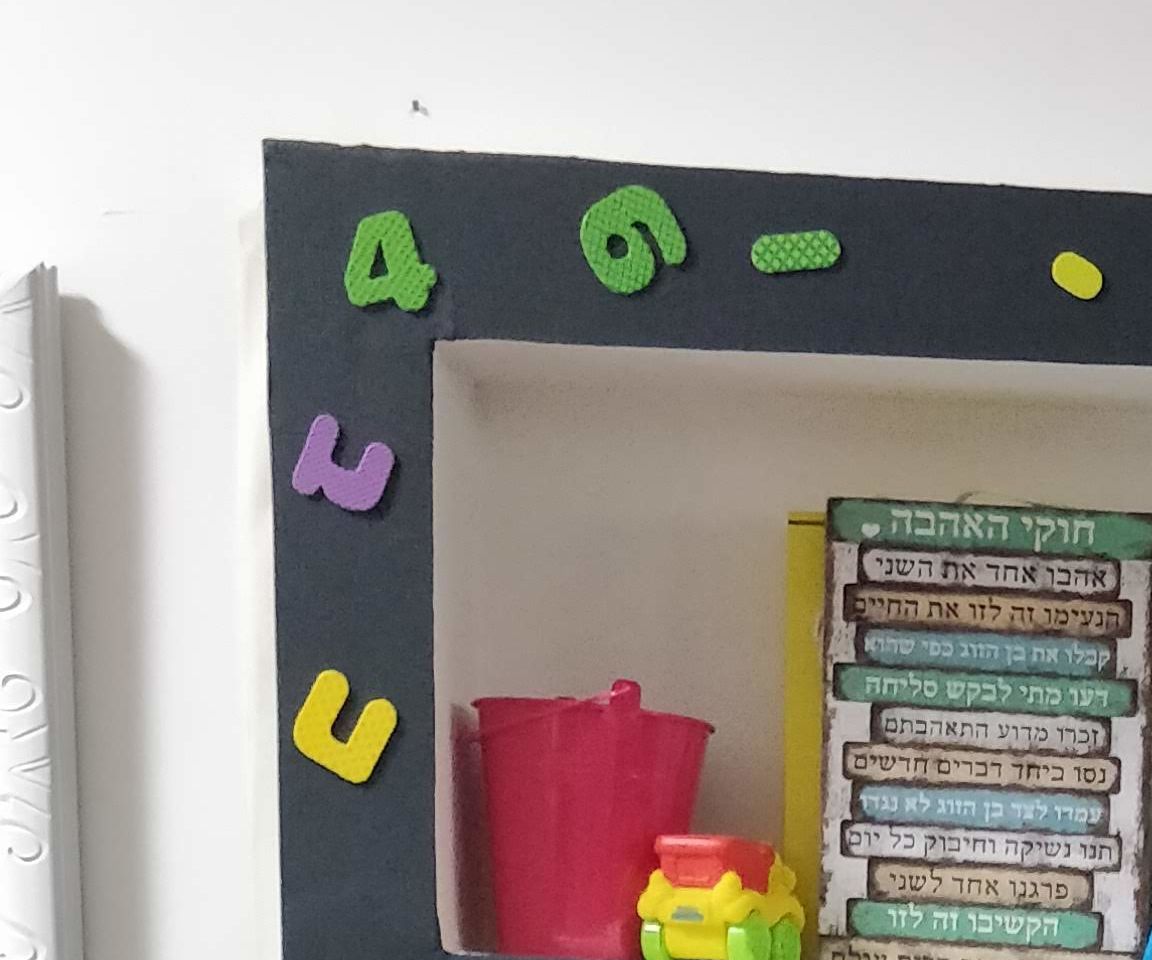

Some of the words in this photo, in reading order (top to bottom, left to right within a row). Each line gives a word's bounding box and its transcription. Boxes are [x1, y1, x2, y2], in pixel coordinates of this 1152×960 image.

[342, 210, 438, 312] 4
[890, 508, 1008, 541] האהבה
[1021, 515, 1095, 552] חוקי
[876, 556, 933, 578] השני
[942, 560, 976, 581] את
[987, 562, 1037, 585] אחד
[1046, 567, 1107, 588] אהבו
[854, 597, 919, 618] החיים
[927, 600, 959, 619] את
[968, 597, 1001, 621] לזו
[1009, 604, 1035, 623] זה
[920, 640, 954, 657] כפי
[960, 642, 999, 660] הזוג
[1005, 645, 1025, 666] בן
[1032, 647, 1058, 663] את
[1065, 641, 1110, 672] קבלו
[865, 672, 937, 698] סליחה
[946, 680, 1009, 706] לבקש
[1019, 686, 1061, 706] מתי
[1069, 688, 1108, 707] דעו
[885, 716, 989, 739] התאהבתם
[999, 724, 1048, 744] מדוע
[1056, 725, 1099, 745] זכרו
[854, 755, 928, 775] חדשים
[938, 758, 1003, 779] דברים
[1012, 762, 1064, 782] ביחד
[1073, 766, 1106, 784] נסו
[860, 794, 898, 812] נגדו
[905, 792, 930, 813] לא
[937, 798, 976, 816] הזוג
[983, 801, 1004, 822] בן
[1012, 798, 1048, 820] לצד
[1054, 804, 1103, 826] עמדו
[849, 831, 881, 848] יום
[889, 826, 915, 850] כל
[924, 832, 996, 857] וחיבוק
[1005, 838, 1071, 863] נשיקה
[1080, 843, 1113, 862] תנו
[889, 869, 942, 894] לשני
[952, 876, 999, 896] אחד
[1009, 880, 1068, 900] פרגנו
[888, 902, 924, 930] לזו
[933, 911, 958, 932] זה
[967, 914, 1059, 945] הקשיבו
